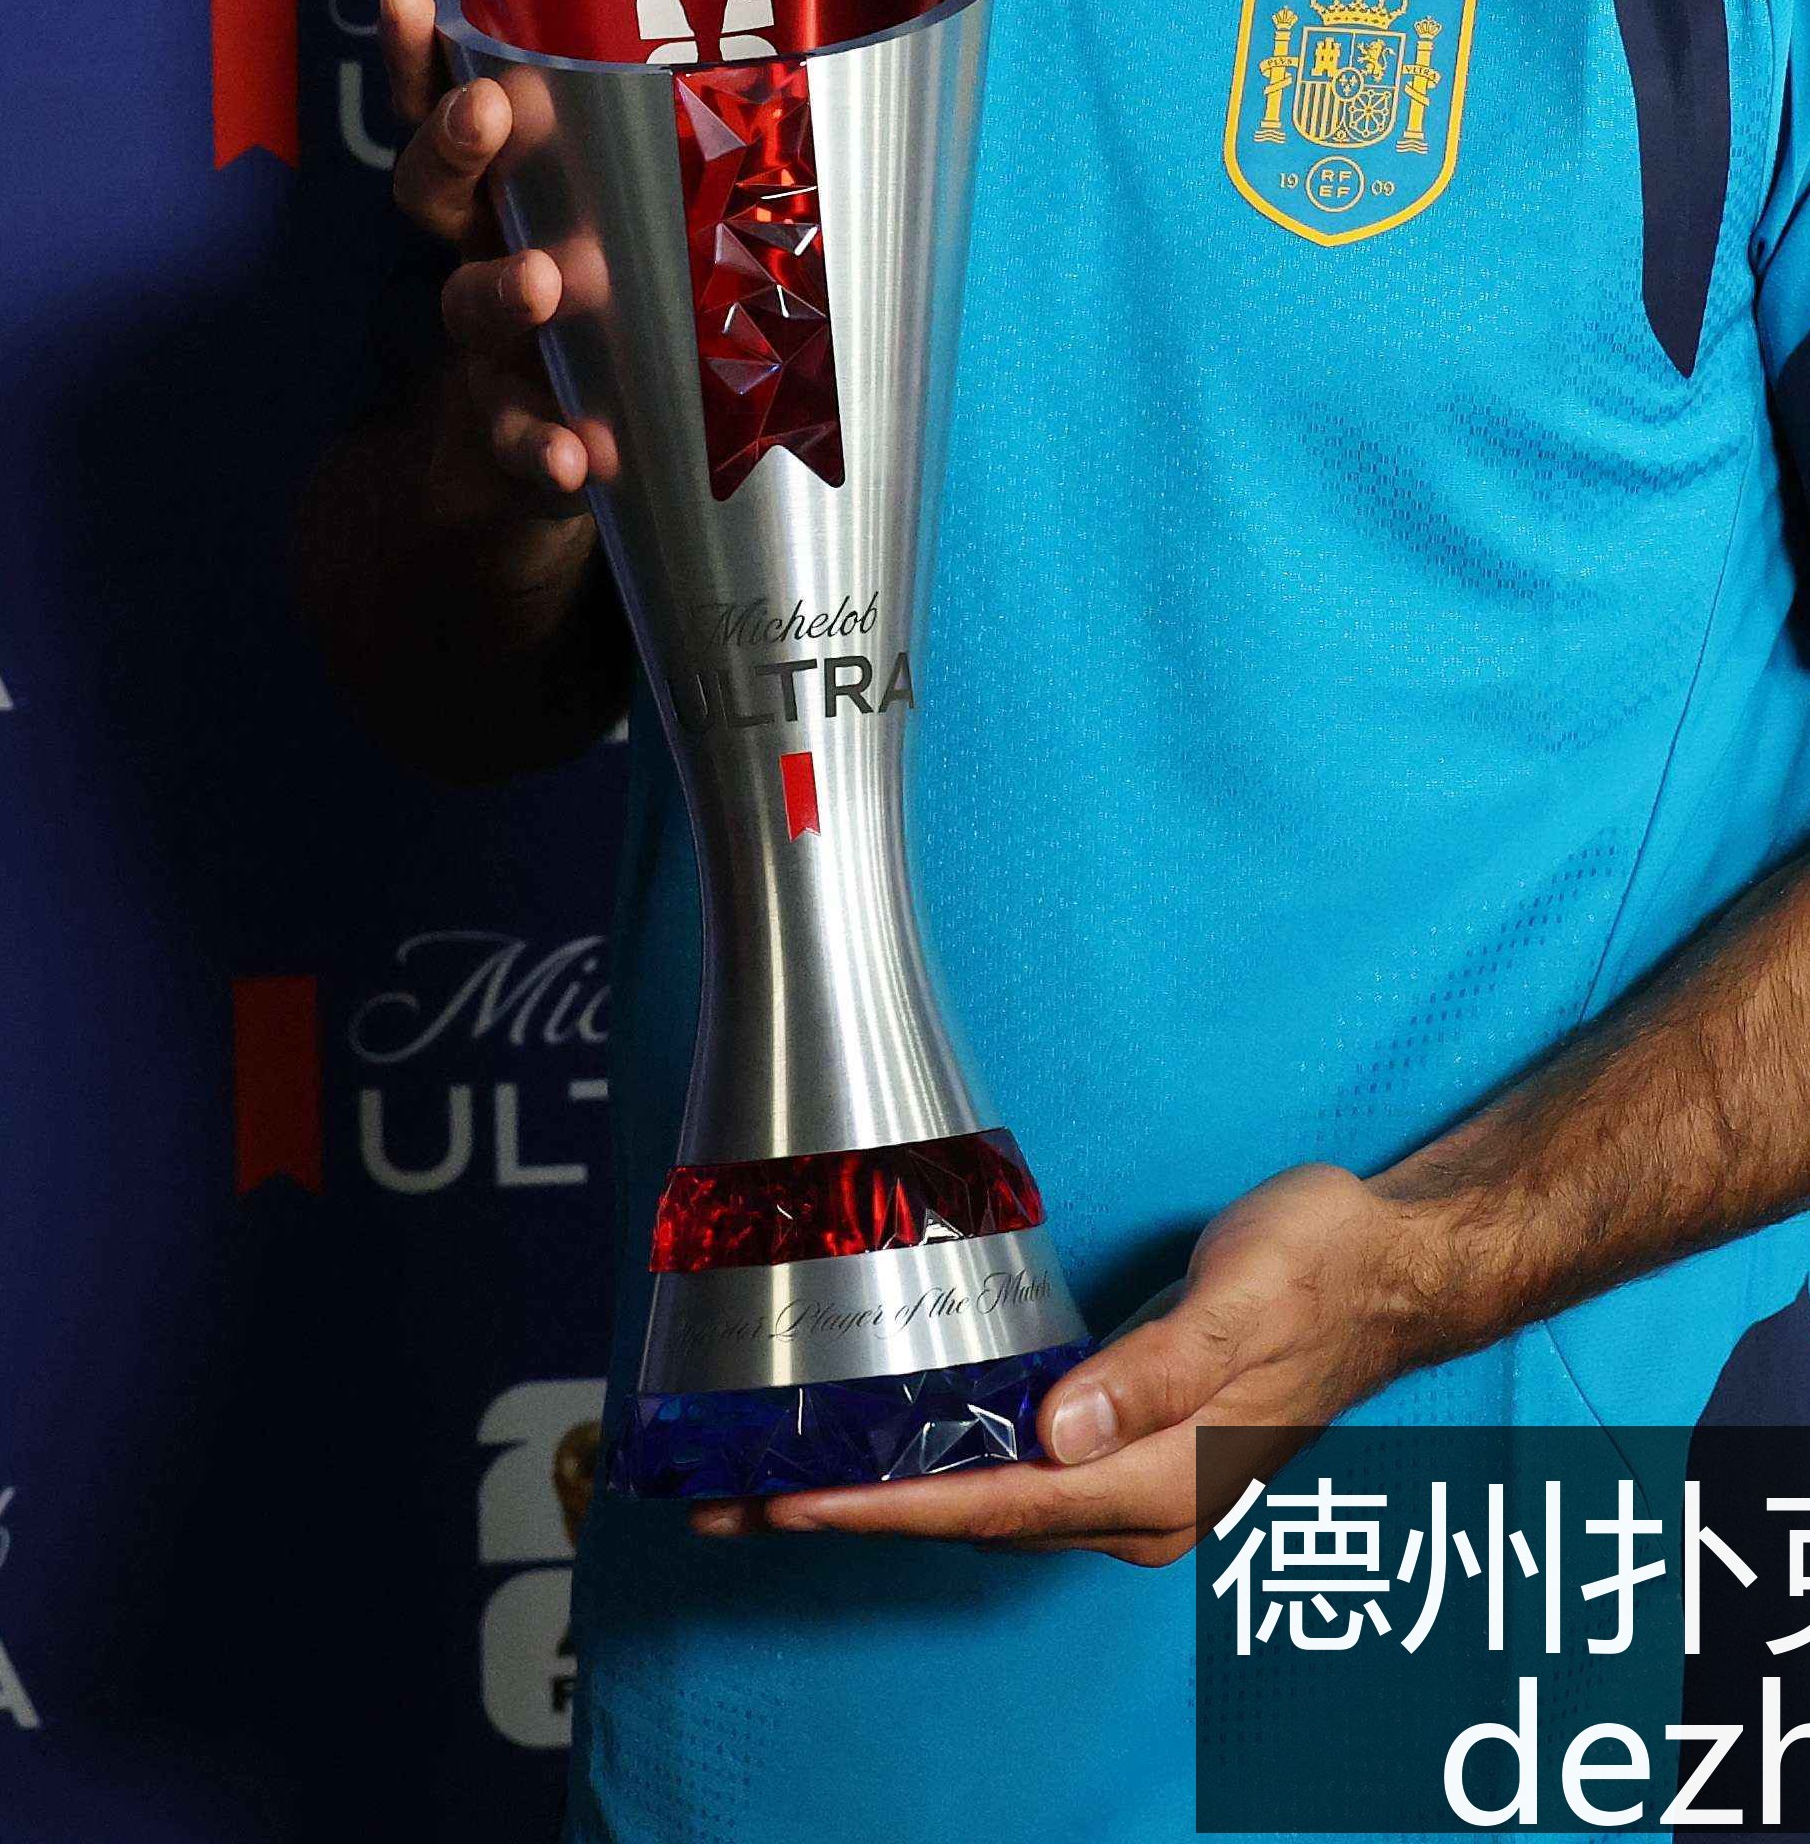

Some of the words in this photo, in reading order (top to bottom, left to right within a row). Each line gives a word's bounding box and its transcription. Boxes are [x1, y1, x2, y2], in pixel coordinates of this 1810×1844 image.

[1280, 172, 1299, 189] 19
[690, 591, 879, 648] Michelob
[767, 1298, 885, 1343] Player
[880, 1286, 930, 1339] of
[927, 1285, 970, 1317] the
